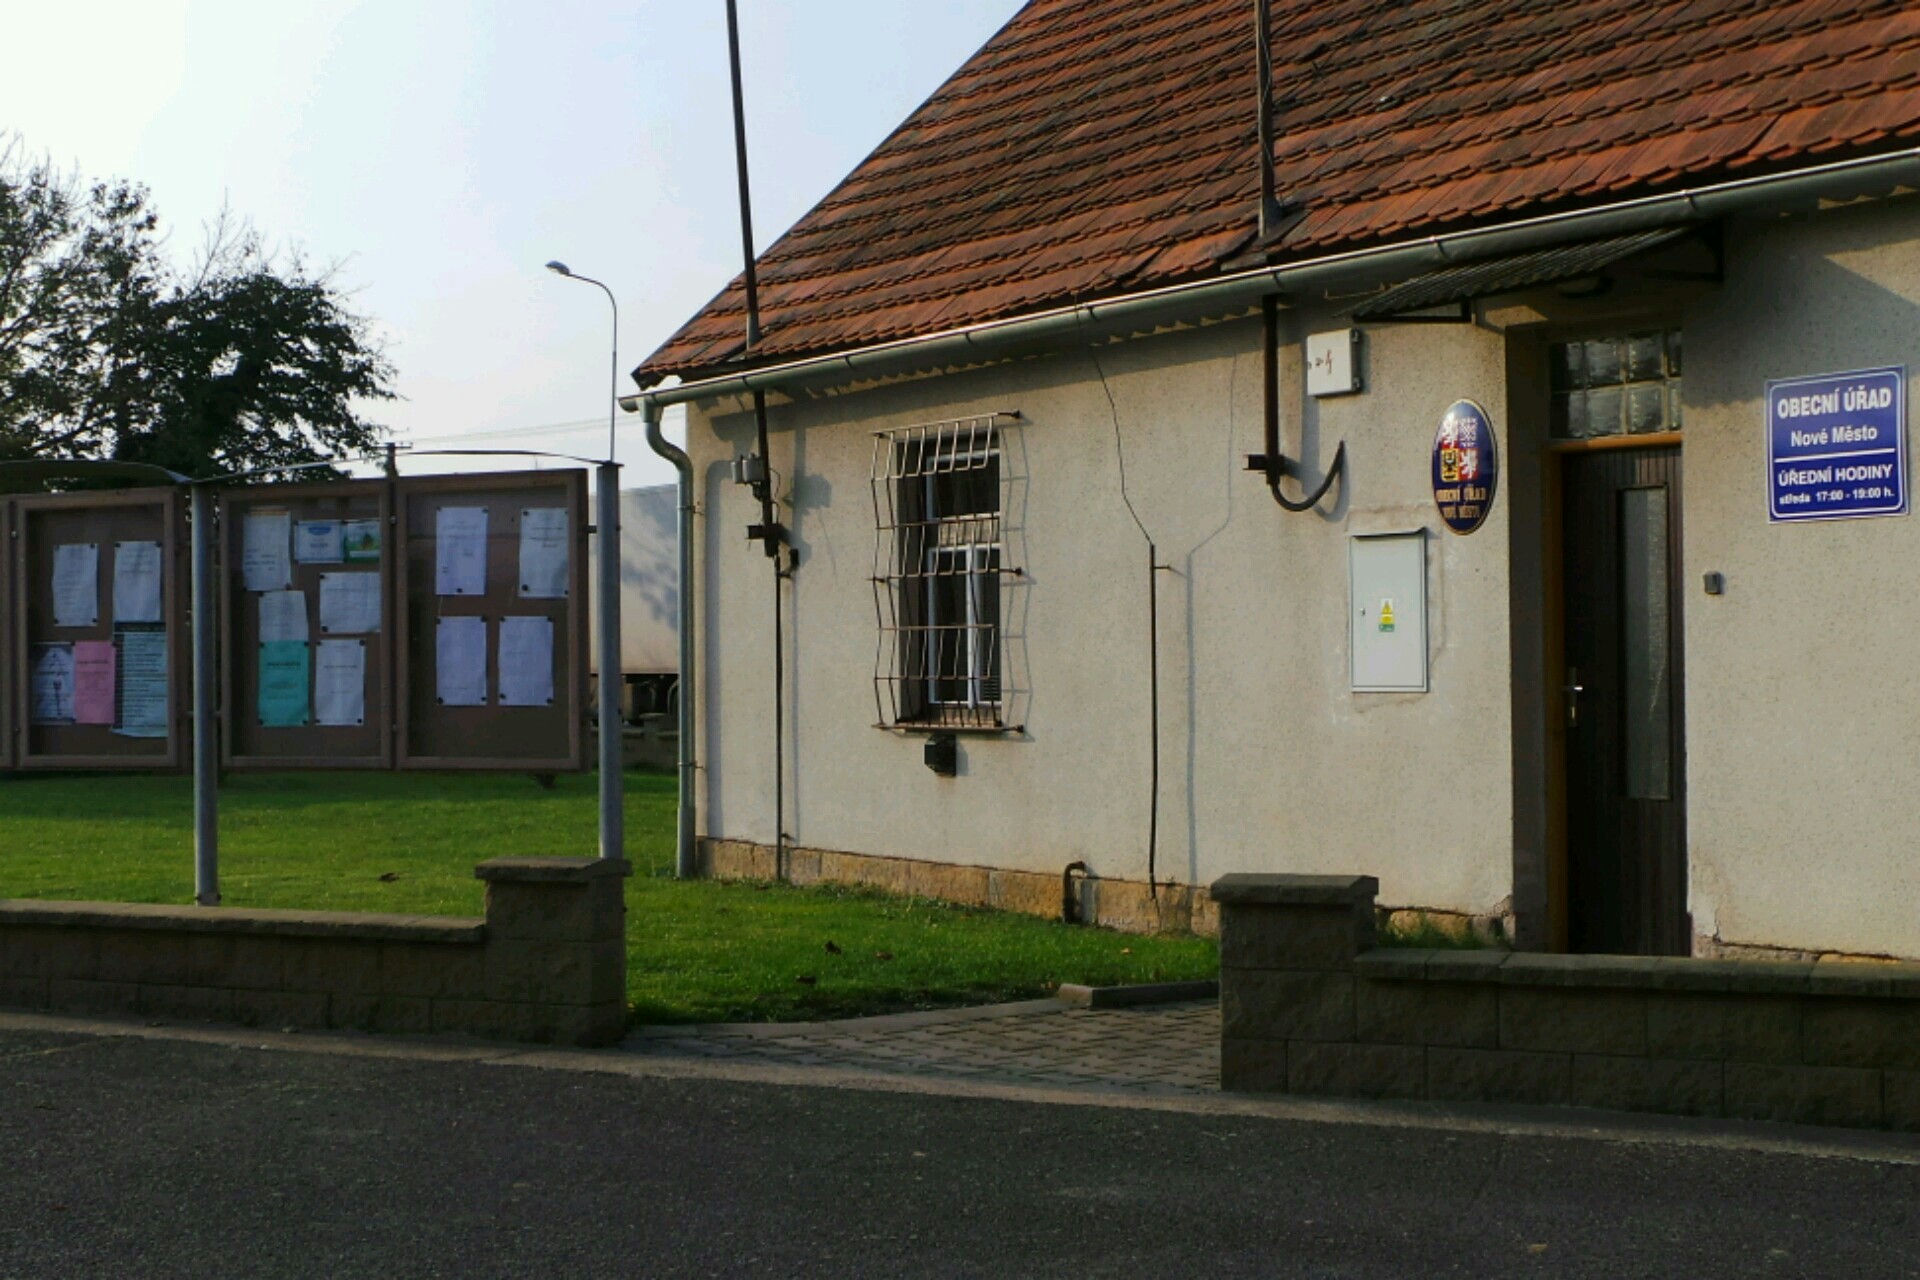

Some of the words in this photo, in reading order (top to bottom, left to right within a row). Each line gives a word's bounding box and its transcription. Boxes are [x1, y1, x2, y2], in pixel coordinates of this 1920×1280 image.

[1777, 388, 1840, 419] OBECNÍ
[1844, 385, 1892, 412] ÚŘAD
[1791, 429, 1828, 447] Nové
[1832, 426, 1877, 443] Město
[1778, 466, 1832, 487] ÚŘEDNÍ
[1835, 464, 1893, 482] HODINY
[1815, 489, 1843, 502] 17:00
[1883, 486, 1895, 498] h.
